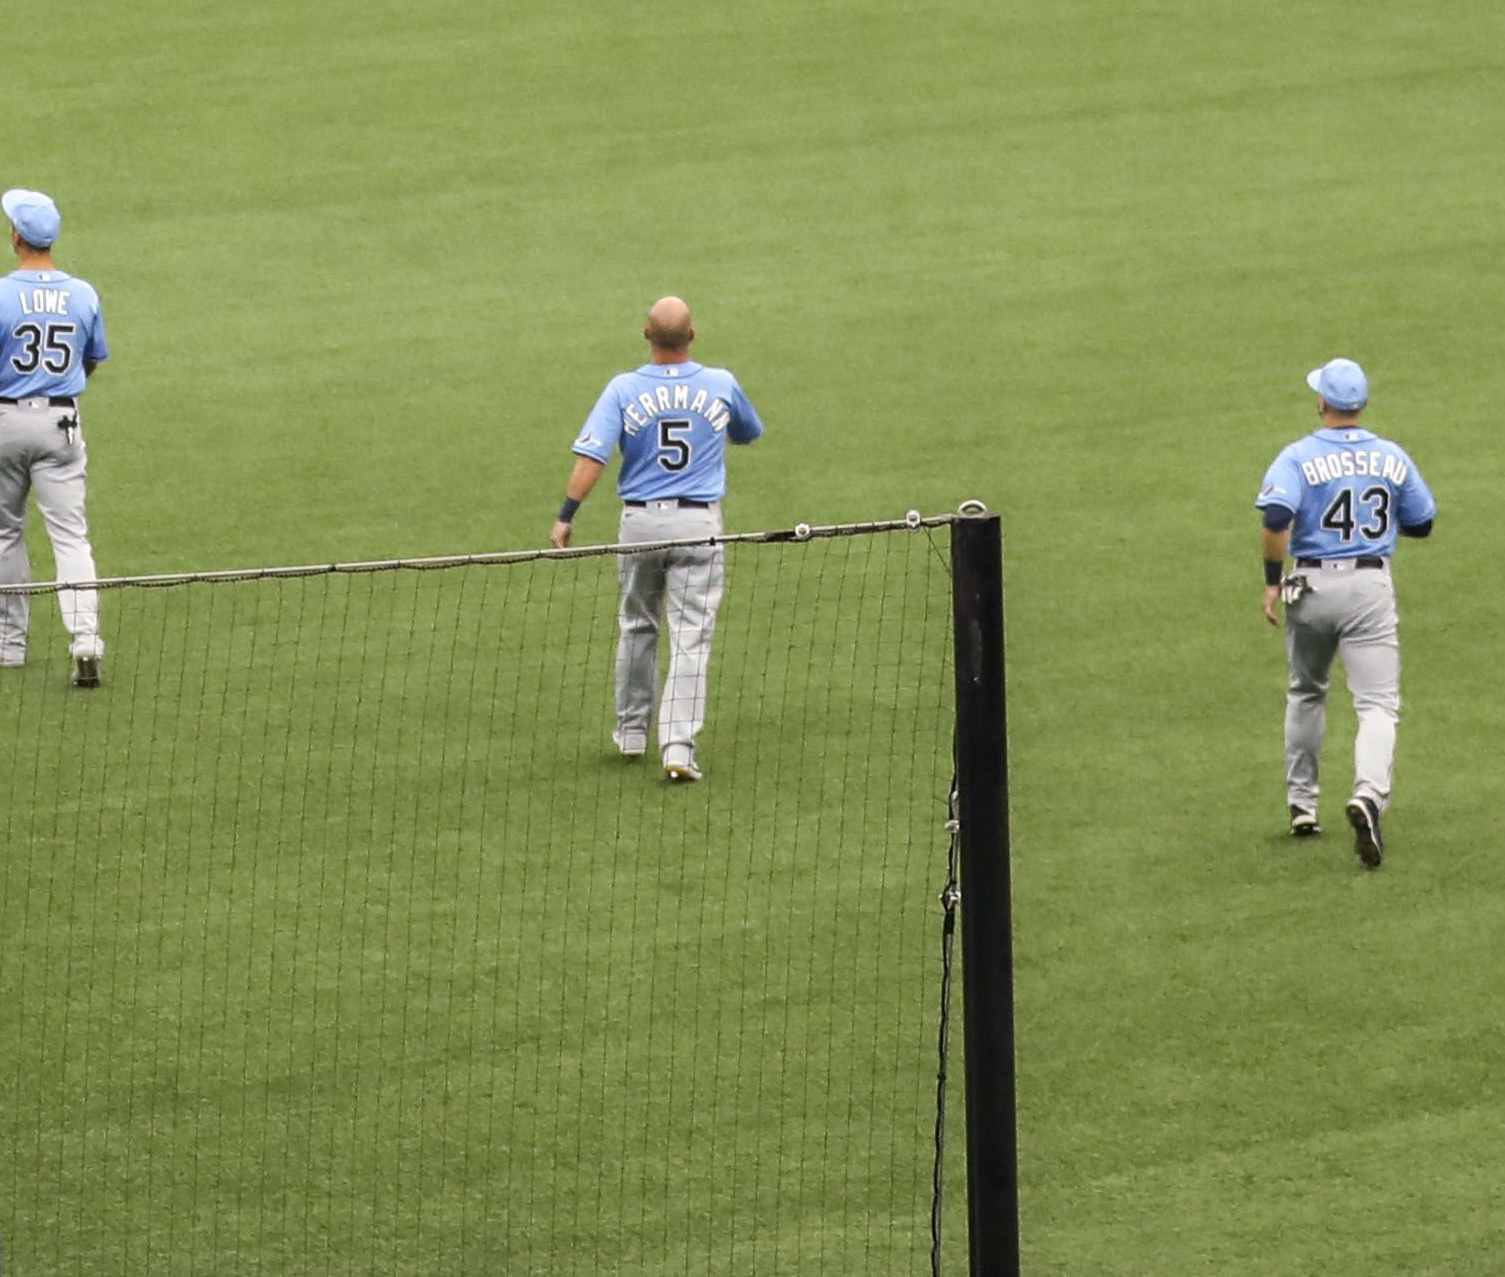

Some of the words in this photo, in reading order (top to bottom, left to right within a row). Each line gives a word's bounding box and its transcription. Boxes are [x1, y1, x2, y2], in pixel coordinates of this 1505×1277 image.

[18, 289, 71, 316] LOWE
[10, 322, 76, 376] 35
[621, 384, 733, 438] HERRMANN
[656, 418, 692, 474] 5
[1301, 450, 1408, 487] BROSSEAU
[1320, 485, 1391, 543] 43
